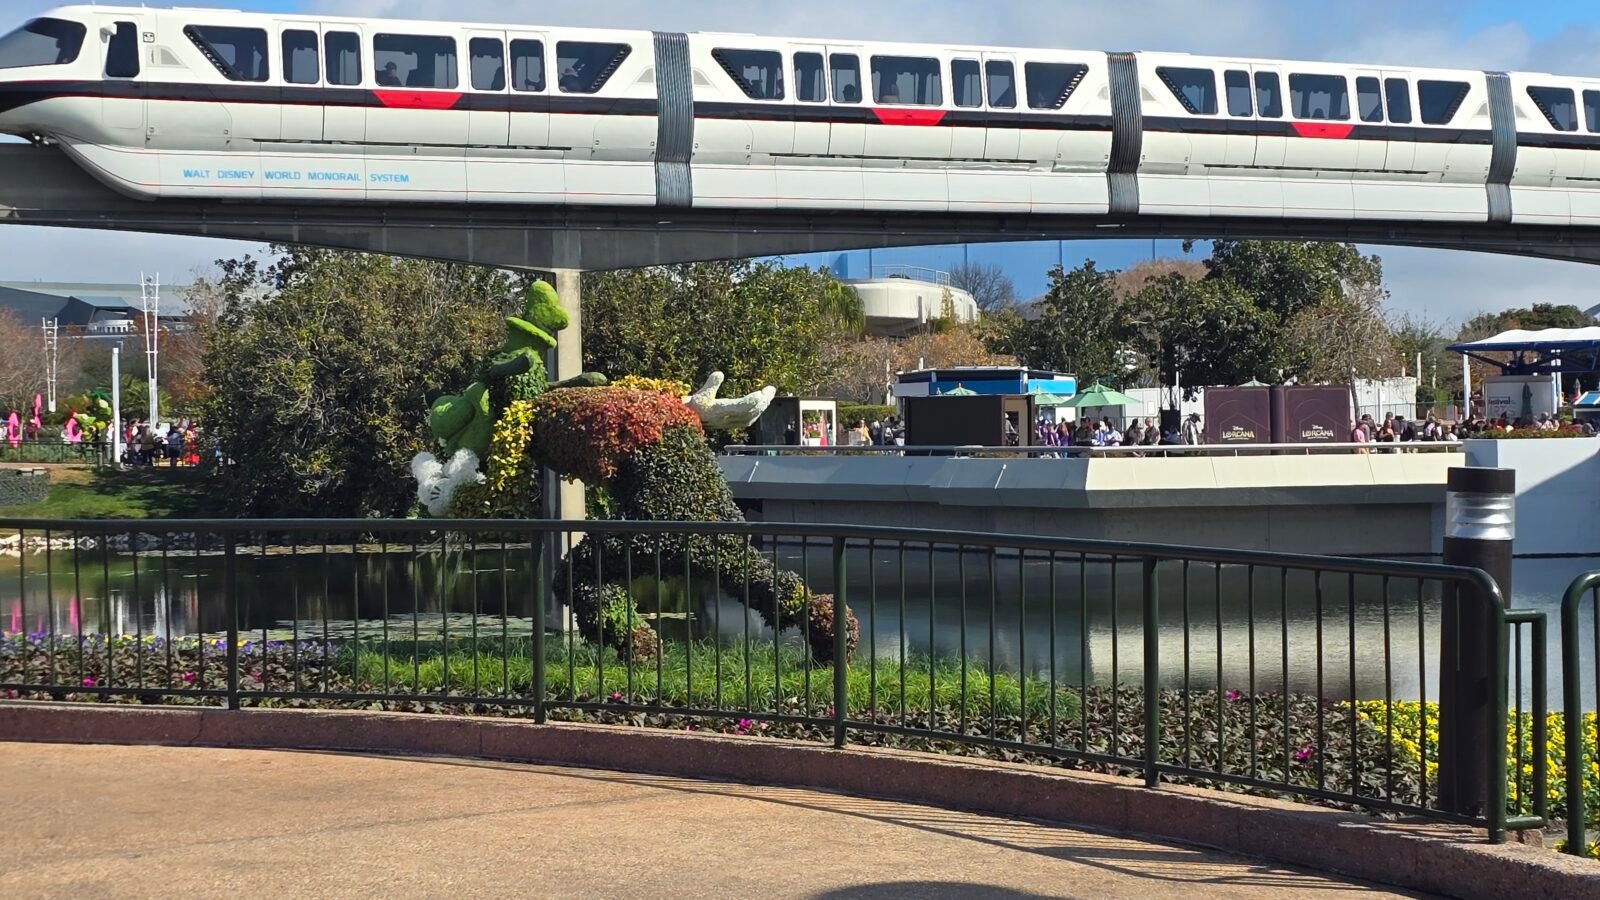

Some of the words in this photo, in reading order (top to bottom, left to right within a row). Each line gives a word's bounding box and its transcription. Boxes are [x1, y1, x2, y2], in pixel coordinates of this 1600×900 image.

[183, 169, 211, 179] WALT
[217, 170, 255, 179] DISNEY
[264, 171, 301, 180] WORLD
[308, 172, 361, 181] MONORAIL
[370, 174, 409, 182] SYSTEM
[1222, 431, 1255, 439] LORCANA
[1302, 430, 1334, 438] LORCANA
